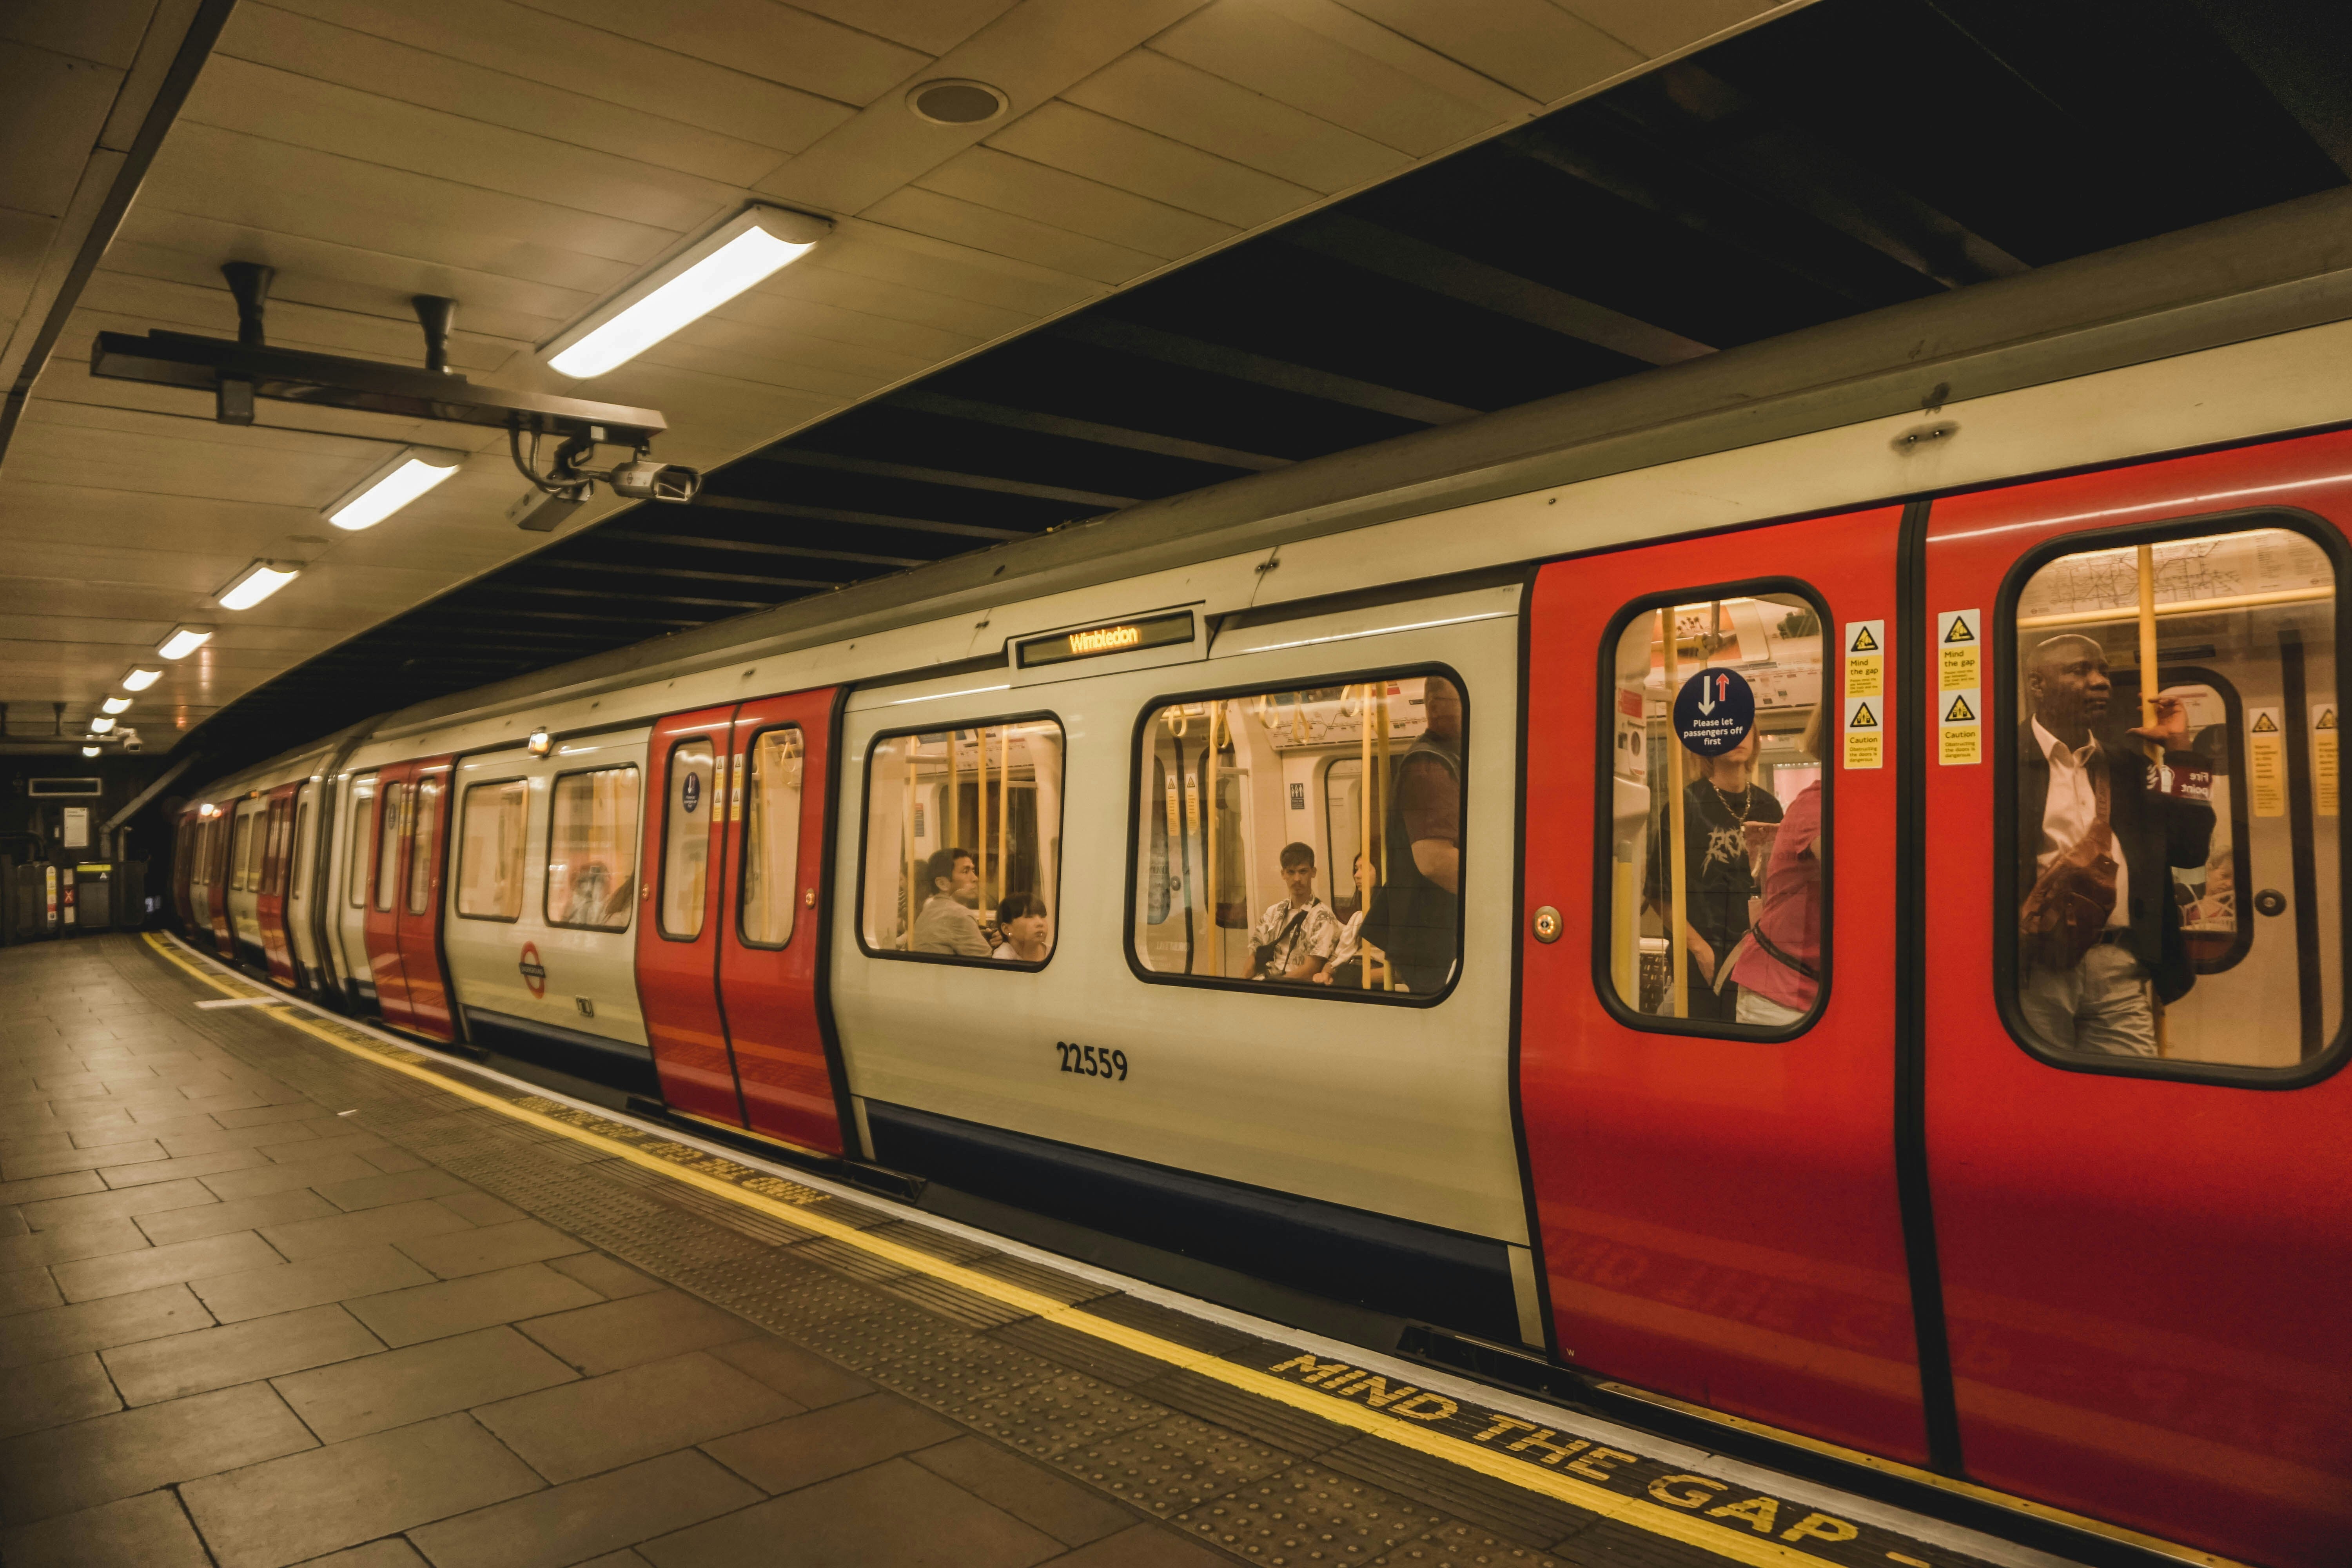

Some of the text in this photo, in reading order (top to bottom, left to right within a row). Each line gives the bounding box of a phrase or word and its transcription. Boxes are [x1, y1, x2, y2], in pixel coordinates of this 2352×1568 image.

[1070, 626, 1138, 652] Wimbledon
[1684, 726, 1743, 739] passengers off
[1693, 719, 1719, 727] Please
[1056, 1041, 1128, 1081] 22559
[1269, 1354, 1859, 1542] MIND THE GAP
